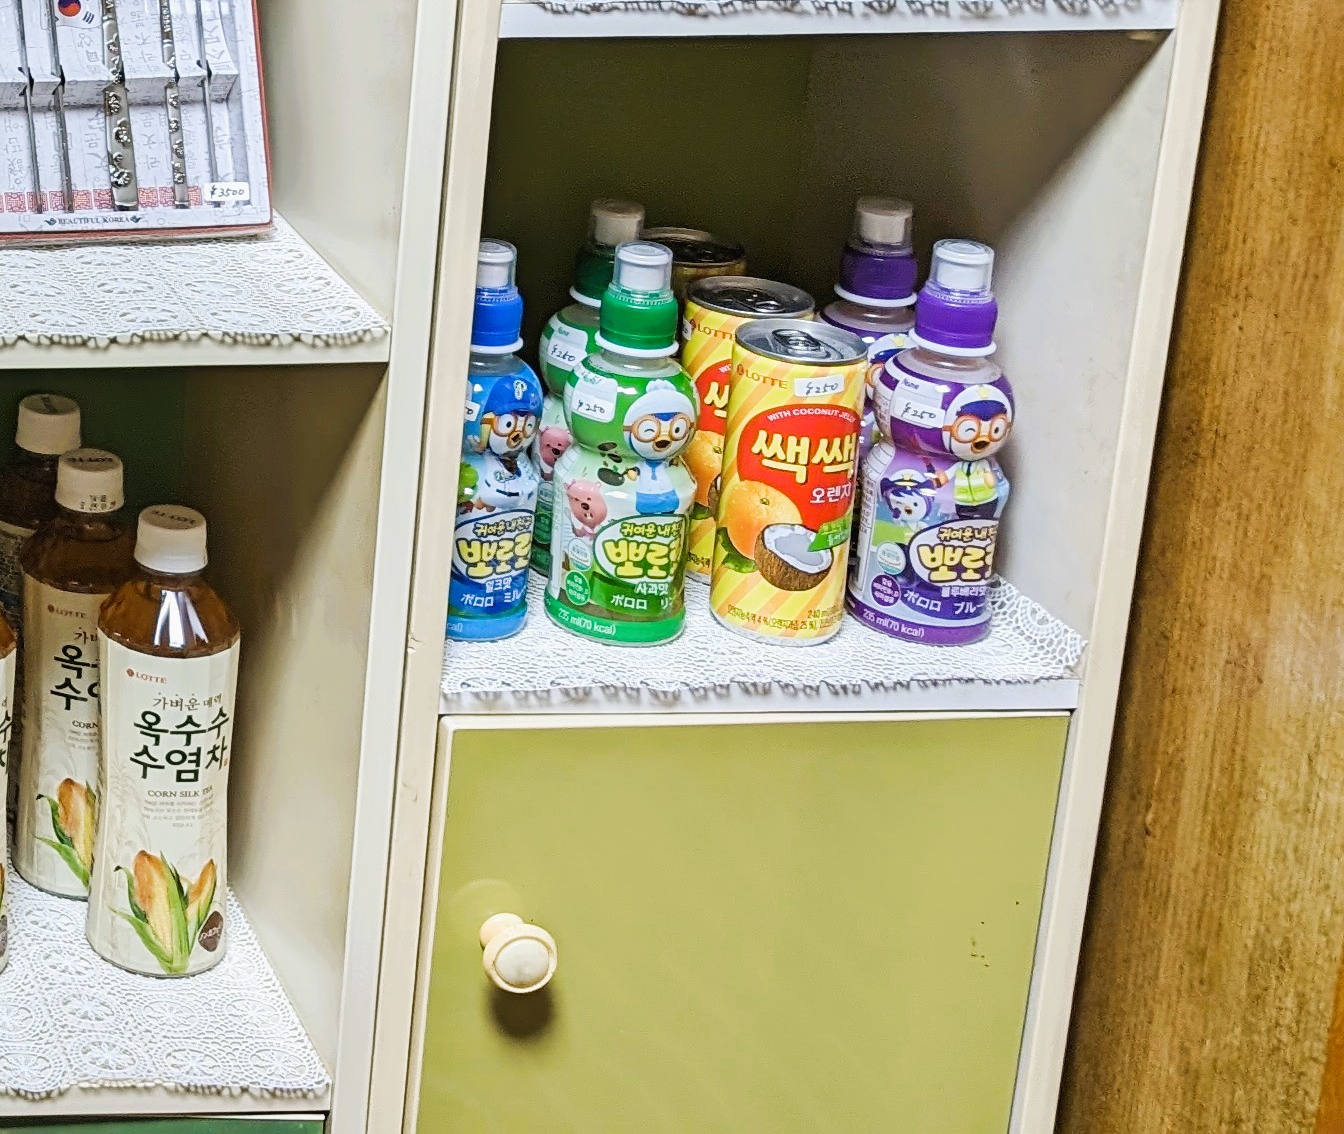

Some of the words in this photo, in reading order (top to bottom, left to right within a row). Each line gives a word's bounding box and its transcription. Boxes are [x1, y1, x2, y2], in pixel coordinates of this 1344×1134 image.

[58, 216, 101, 224] BEAUTIFUL
[103, 216, 130, 224] KOREA
[746, 370, 789, 389] LOTTE
[767, 410, 791, 422] WITH
[792, 408, 839, 416] COCONUT
[839, 411, 857, 423] JELLY
[750, 430, 857, 484] 쌕쌕
[810, 482, 852, 503] 오렌지
[474, 522, 506, 536] 귀여운
[620, 522, 655, 538] 귀여운
[938, 527, 974, 543] 귀여운
[635, 582, 669, 596] 사과맛
[461, 593, 494, 608] ポロロ
[611, 594, 647, 610] ポロロ
[903, 589, 941, 612] ポロロ
[56, 608, 87, 619] LOTTE
[593, 621, 617, 636] kcal)
[901, 622, 925, 638] kcal)
[136, 671, 167, 684] LOTTE
[153, 696, 200, 712] 가벼운
[133, 706, 230, 747] 옥수수
[130, 736, 228, 783] 수염차
[147, 789, 177, 798] CORN
[179, 789, 200, 797] SILK
